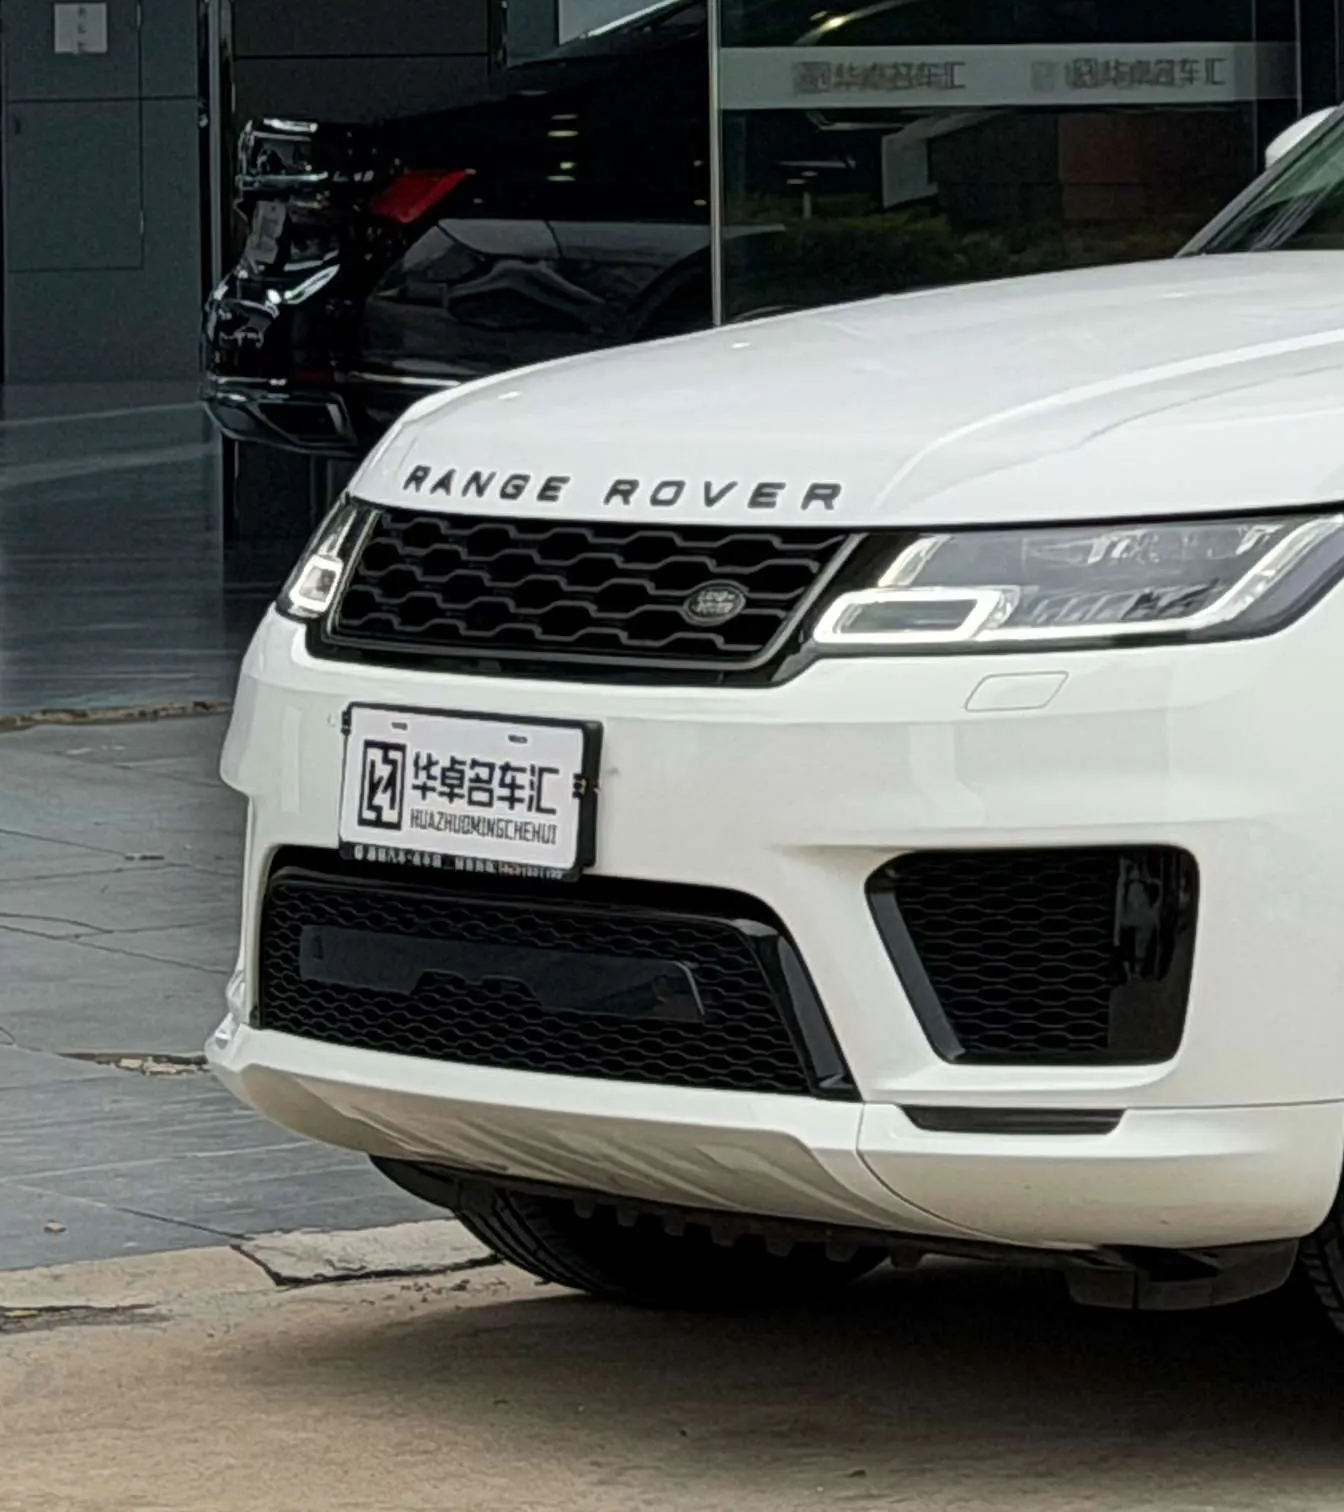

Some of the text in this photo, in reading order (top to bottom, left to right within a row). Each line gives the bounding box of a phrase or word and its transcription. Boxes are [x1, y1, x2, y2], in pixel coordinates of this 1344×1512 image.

[403, 464, 845, 511] RANGE ROVER
[411, 750, 561, 816] 华卓名车汇
[409, 808, 560, 846] HUAZHUOMINGCHEHUI
